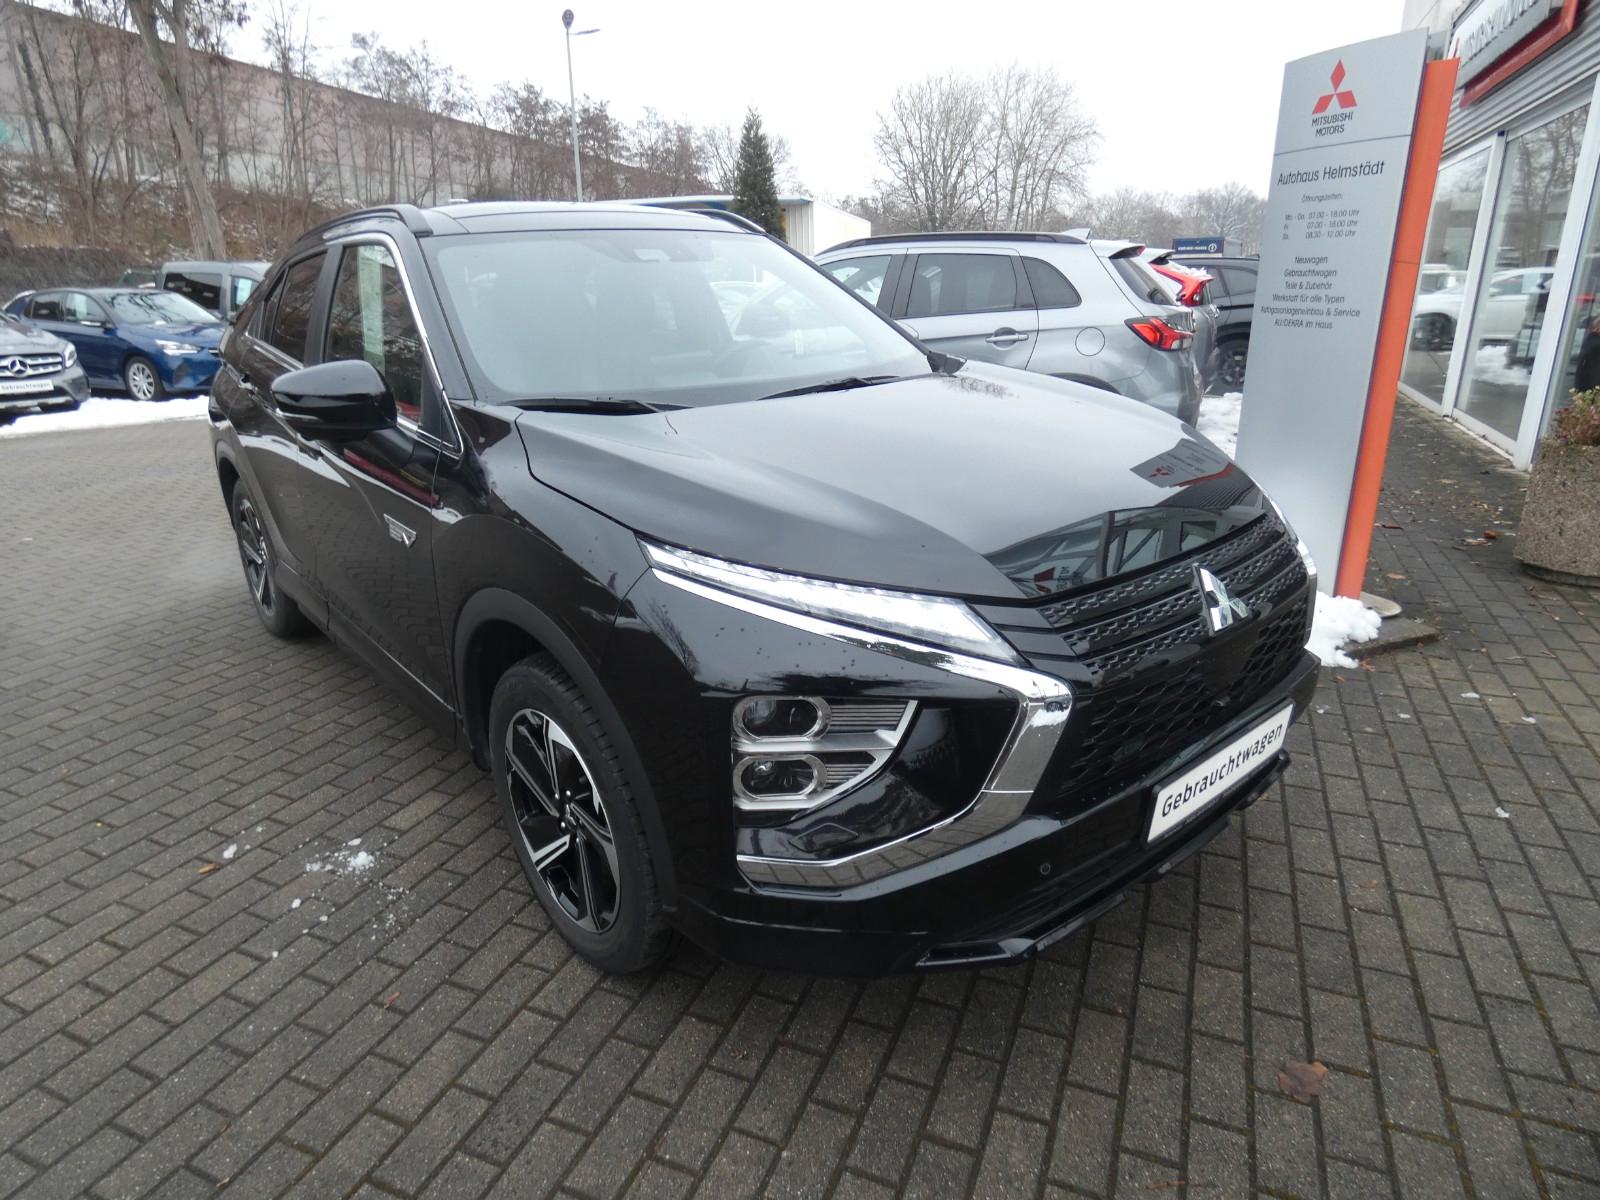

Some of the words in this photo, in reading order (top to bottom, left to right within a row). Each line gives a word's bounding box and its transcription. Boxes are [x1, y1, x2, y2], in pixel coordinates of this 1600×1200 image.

[1311, 111, 1354, 127] MITSUBISHI
[1315, 124, 1345, 137] MOTORS
[1277, 170, 1320, 186] Autohaus
[1322, 160, 1385, 181] Helmstädt
[1294, 256, 1329, 266] Neuwagen
[1283, 268, 1338, 279] Gebrauchtwagen
[1285, 281, 1297, 290] Teile
[1298, 281, 1304, 290] &
[1304, 281, 1333, 290] Zubehör
[1272, 293, 1299, 303] Werkstatt
[1299, 293, 1309, 303] für
[1309, 294, 1322, 303] alle
[1324, 294, 1345, 304] Typen
[1325, 307, 1332, 317] &
[1333, 307, 1361, 318] Service
[1304, 319, 1313, 328] im
[1314, 320, 1334, 329] Haus
[1162, 723, 1283, 818] Gebrauchtwagen
